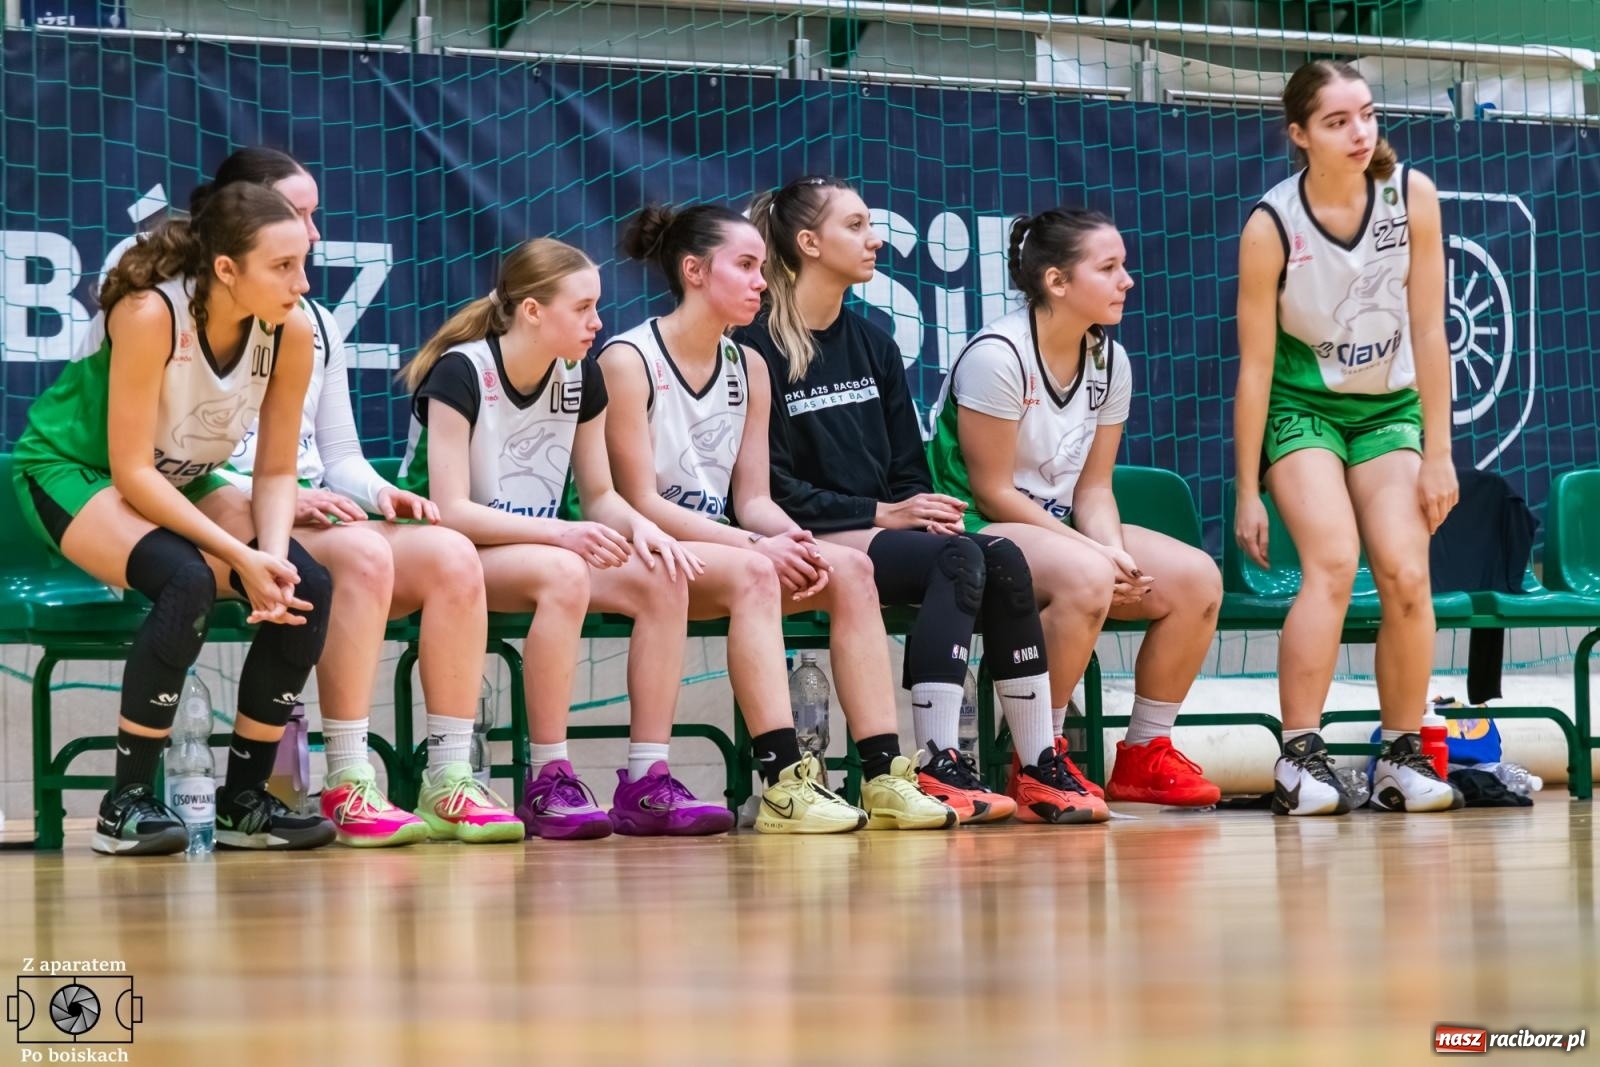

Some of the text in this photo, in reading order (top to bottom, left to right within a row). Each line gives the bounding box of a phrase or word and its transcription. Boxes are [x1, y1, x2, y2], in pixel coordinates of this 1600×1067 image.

[1373, 215, 1409, 252] 27
[550, 381, 582, 414] 15
[726, 374, 744, 407] 3
[810, 385, 829, 397] AZS
[1021, 645, 1039, 662] NBA
